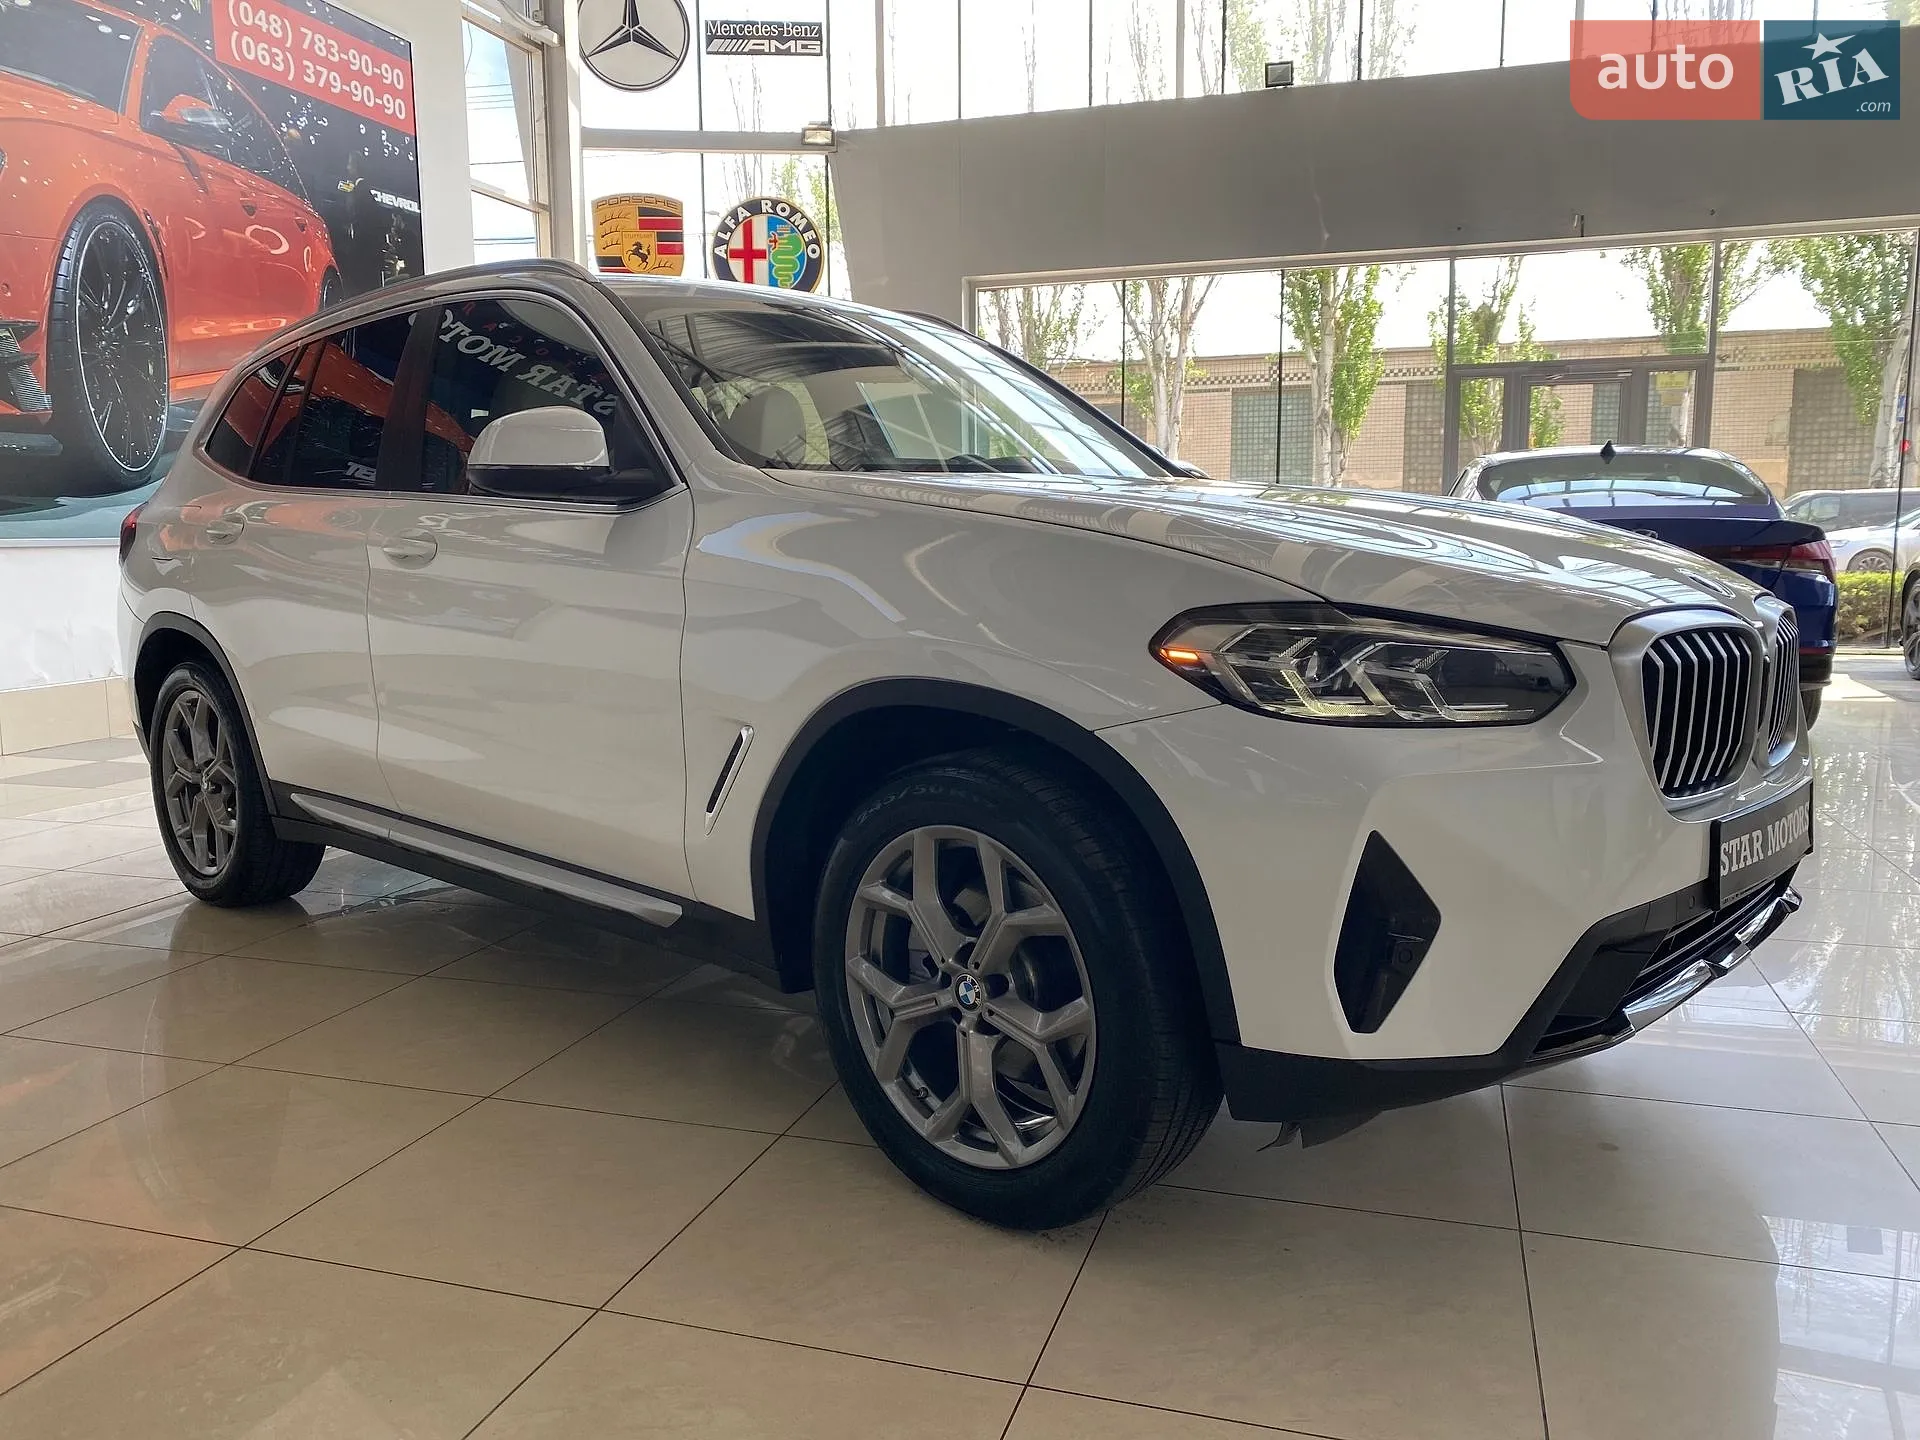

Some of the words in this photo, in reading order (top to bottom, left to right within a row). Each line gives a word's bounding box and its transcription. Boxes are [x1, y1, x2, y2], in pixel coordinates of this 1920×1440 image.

[228, 0, 292, 48] (048)
[300, 27, 404, 90] 783-90-90
[706, 21, 819, 37] Mercedes-Benz
[231, 31, 295, 81] (063)
[302, 60, 406, 120] 379-90-90
[596, 195, 680, 210] PORSCHE
[714, 206, 752, 260] ALFA
[761, 199, 821, 259] ROMEO
[1720, 829, 1764, 877] STAR
[1767, 801, 1811, 856] MOTORS
